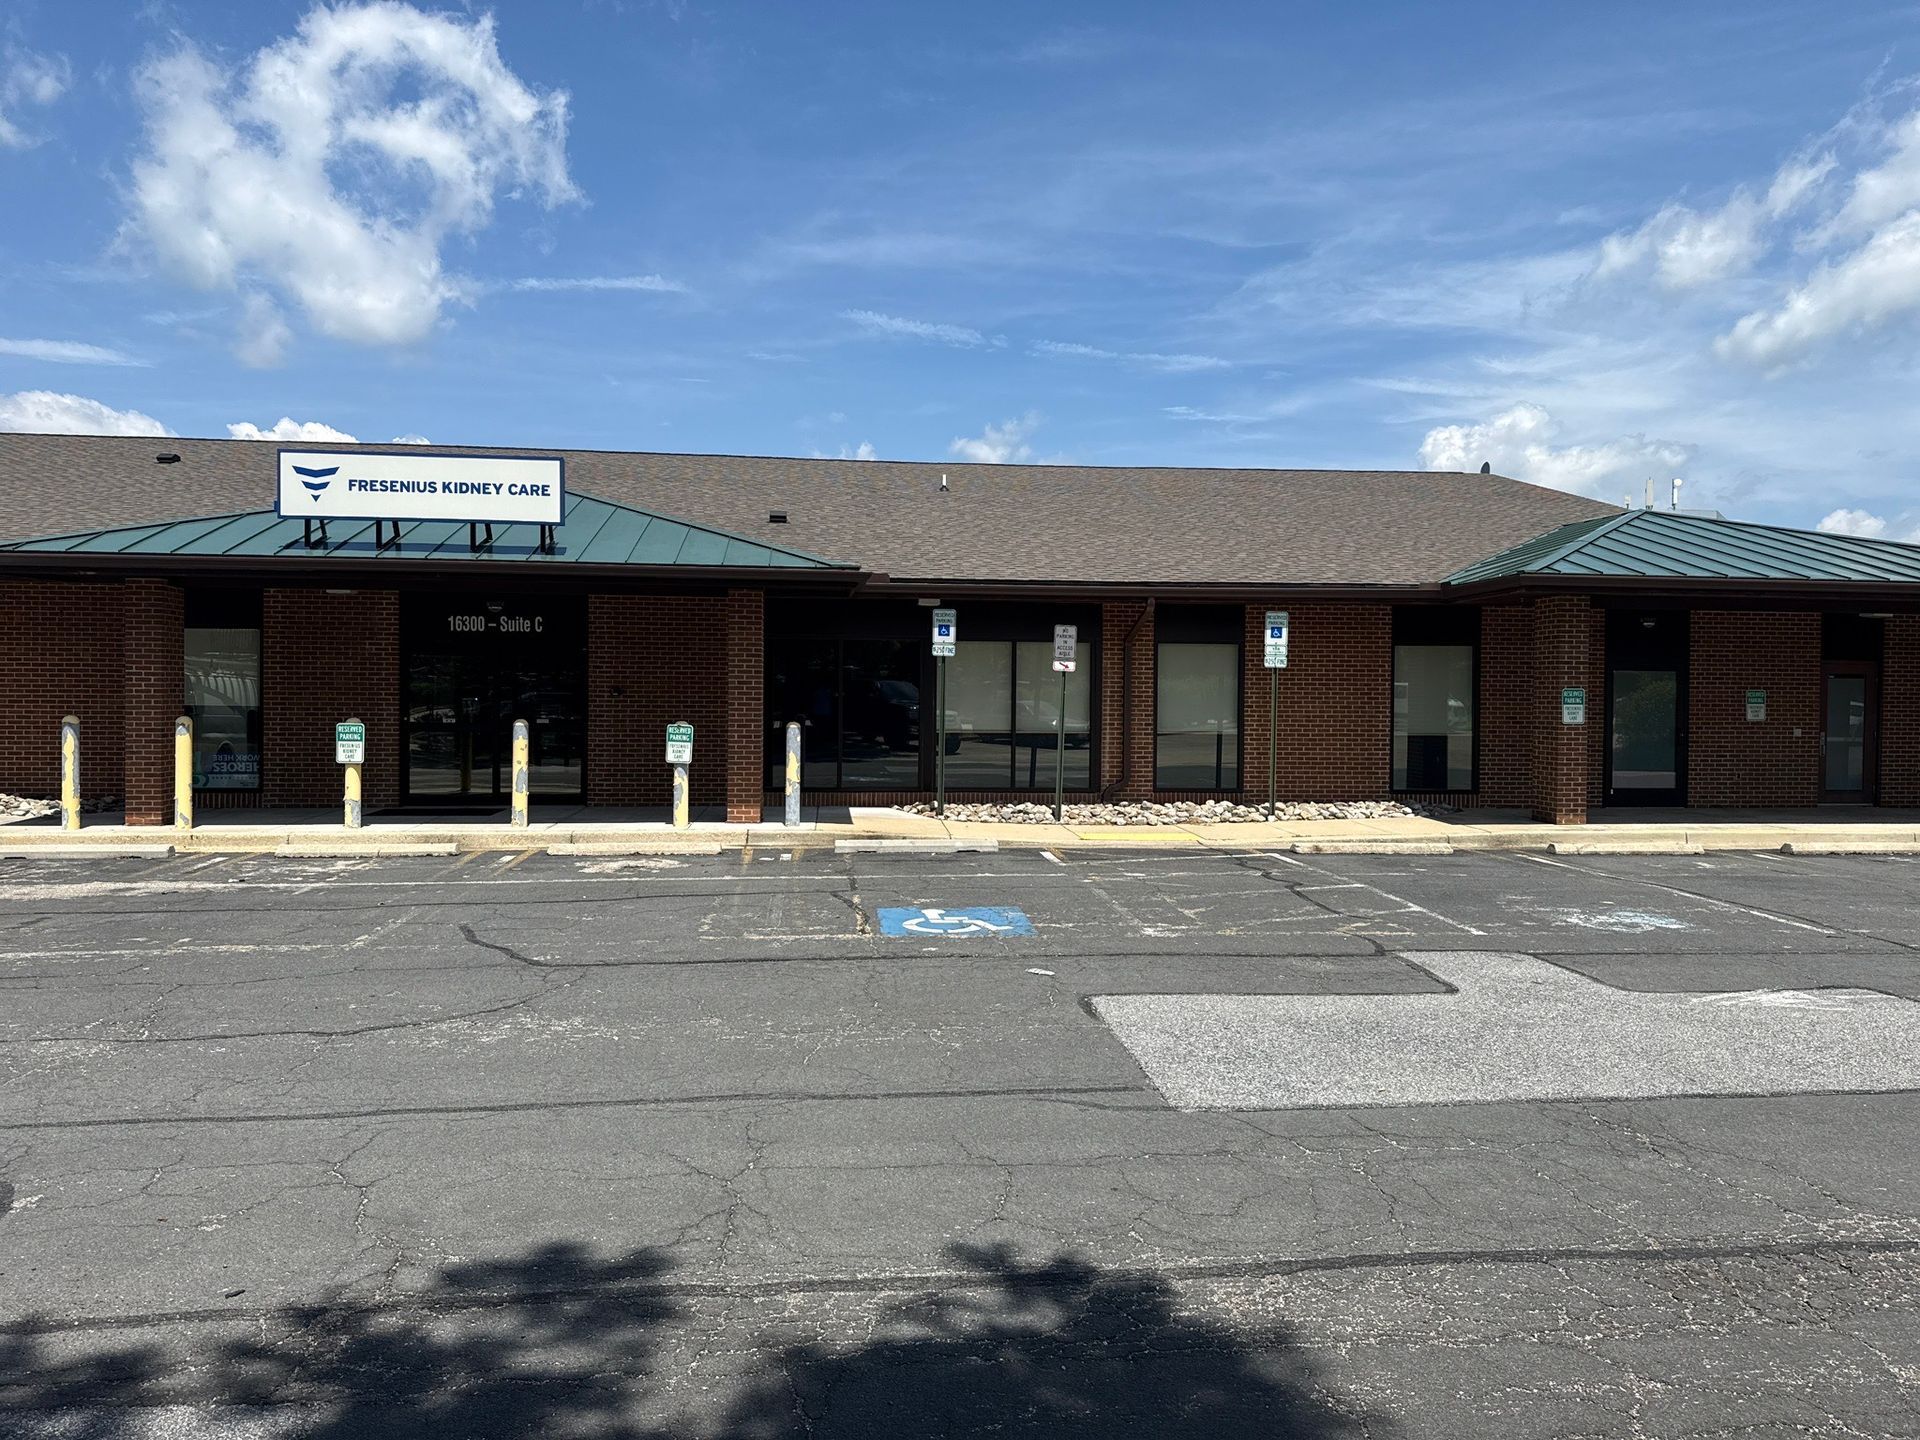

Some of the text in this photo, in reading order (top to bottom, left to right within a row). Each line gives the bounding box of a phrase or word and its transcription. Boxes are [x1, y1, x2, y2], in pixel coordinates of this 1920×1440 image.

[348, 479, 551, 497] FRESENIUS KIDNEY CARE
[448, 615, 485, 632] 16300
[500, 616, 531, 632] Suite
[535, 616, 543, 632] C
[338, 725, 362, 733] RESERVED
[669, 726, 691, 734] RESERVED
